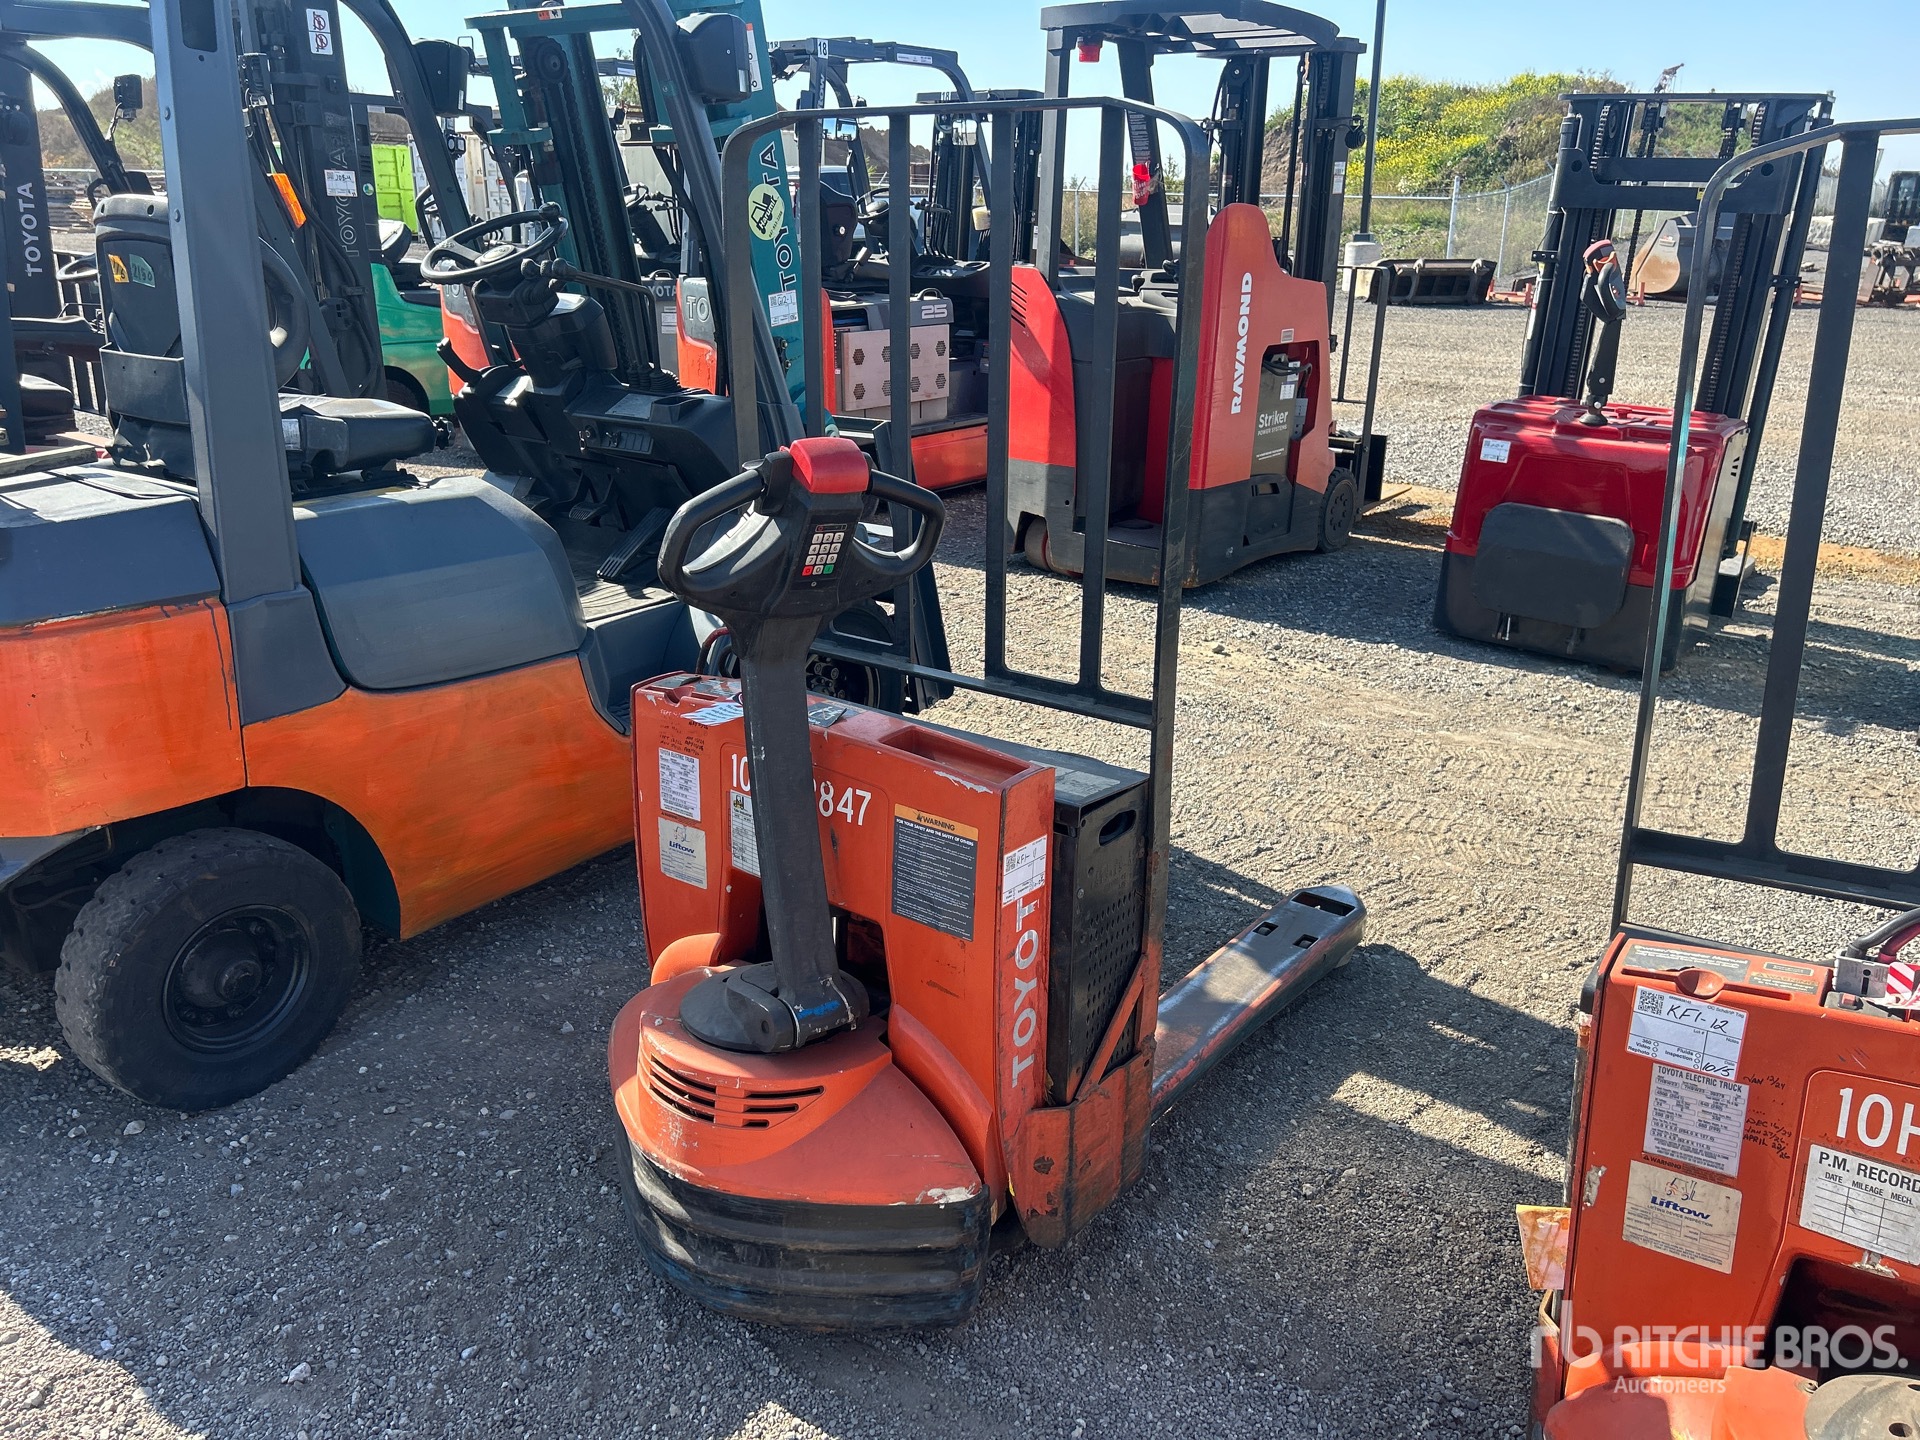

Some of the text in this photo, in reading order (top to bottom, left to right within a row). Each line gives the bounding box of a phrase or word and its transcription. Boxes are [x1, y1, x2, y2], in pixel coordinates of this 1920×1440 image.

[818, 41, 827, 57] 18
[942, 92, 950, 100] 18
[17, 182, 43, 277] TOYOTA
[921, 304, 948, 320] 25
[1231, 272, 1252, 414] RAYMOND
[1258, 410, 1289, 428] Striker
[813, 779, 872, 826] 847
[923, 815, 955, 831] WARNING
[669, 840, 695, 853] Liftow
[1012, 897, 1039, 1088] TOYOT
[1635, 1042, 1651, 1050] Video
[1677, 1047, 1694, 1056] Fluids
[1665, 1050, 1693, 1062] Inspection
[1658, 1066, 1742, 1093] TOYOTA ELECTRIC TRUCK
[1650, 1156, 1682, 1170] WARNING
[1818, 1151, 1920, 1193] P.M. RECORD
[1824, 1171, 1843, 1184] DATE
[1851, 1180, 1884, 1197] MILEAGE
[1650, 1195, 1711, 1220] Liftow
[1666, 1209, 1684, 1219] DEVICE
[1684, 1215, 1713, 1228] INSPECTION
